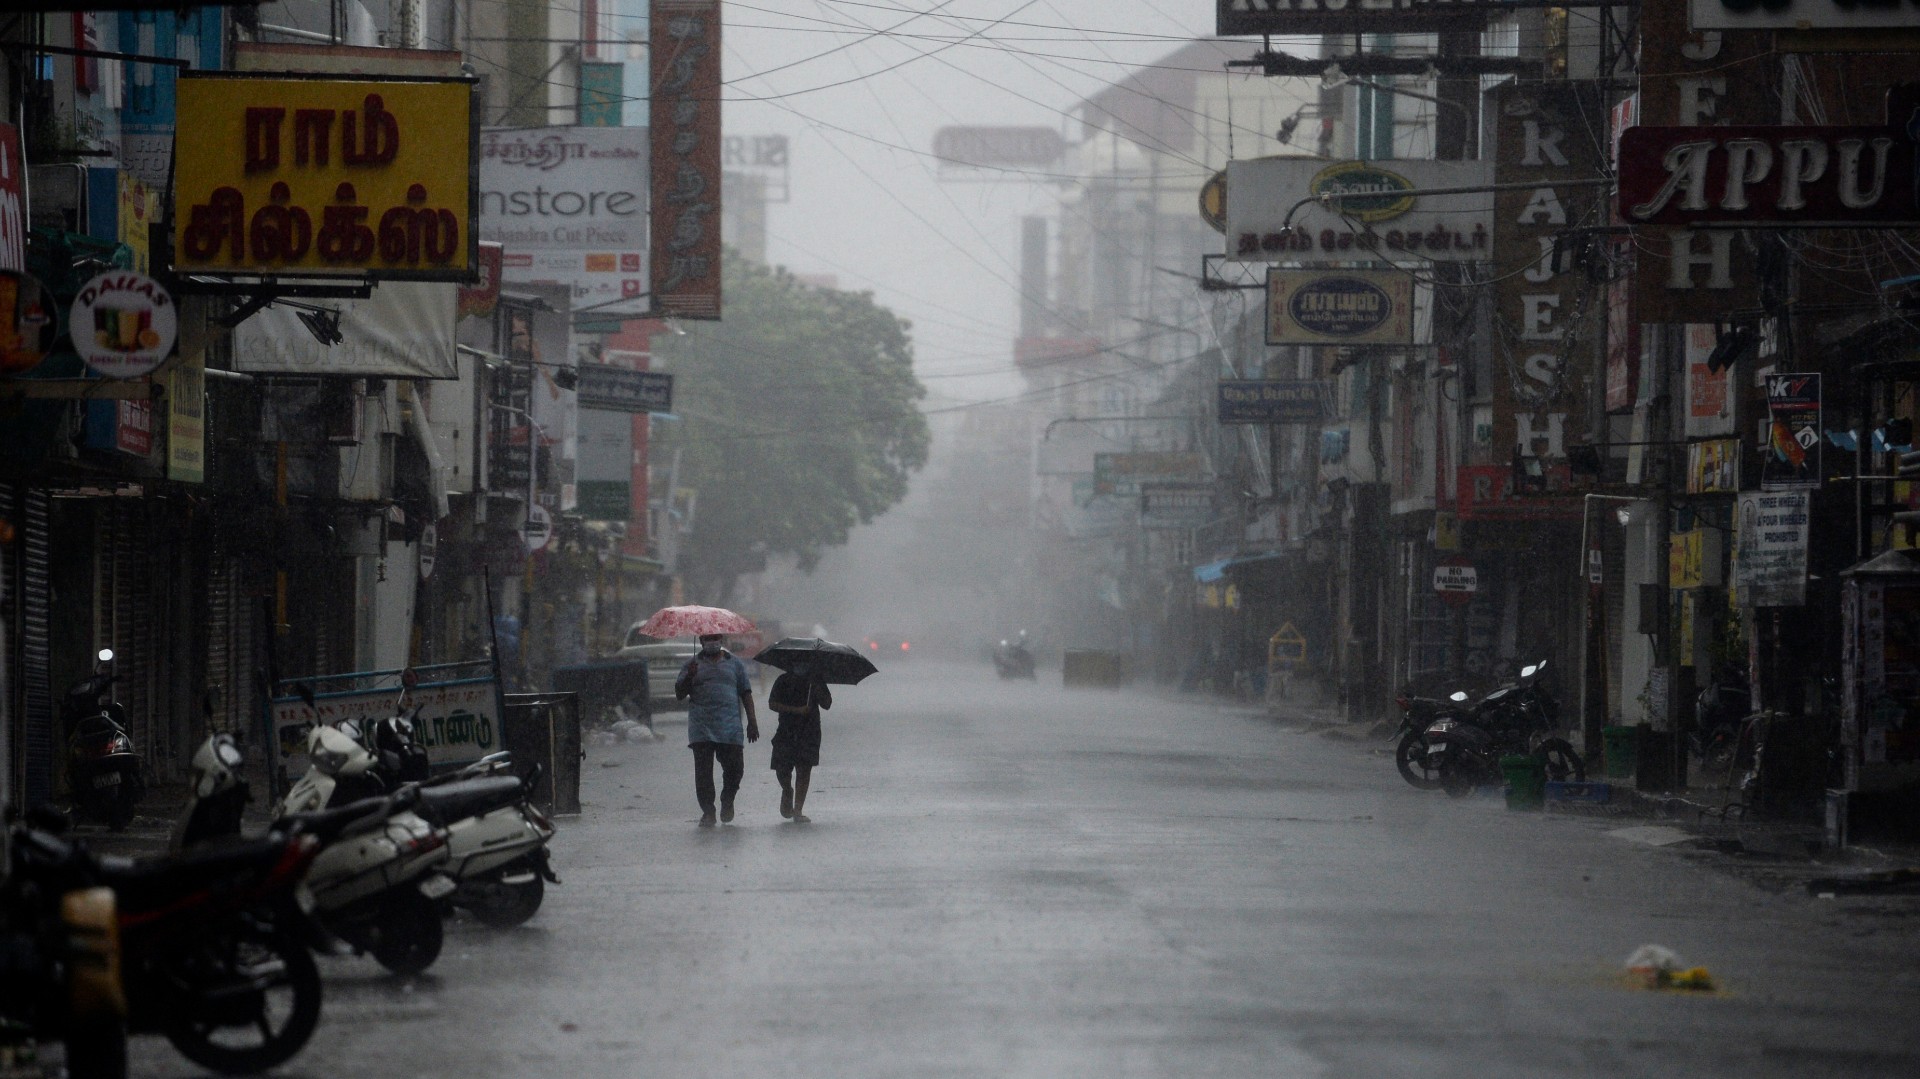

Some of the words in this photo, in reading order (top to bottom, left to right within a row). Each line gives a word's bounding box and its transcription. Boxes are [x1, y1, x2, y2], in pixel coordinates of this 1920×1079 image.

[244, 93, 399, 178] ராம்
[1631, 137, 1893, 219] APPU
[183, 181, 458, 263] சில்க்ஸ்
[79, 275, 169, 308] DALLAS
[1759, 497, 1777, 509] THREE
[1778, 496, 1806, 508] WHEELER
[1762, 514, 1779, 526] FOUR
[1779, 514, 1807, 525] WHEELER
[1764, 531, 1799, 543] PROHIBITED
[1448, 567, 1462, 575] NO
[1436, 575, 1476, 585] PARKING
